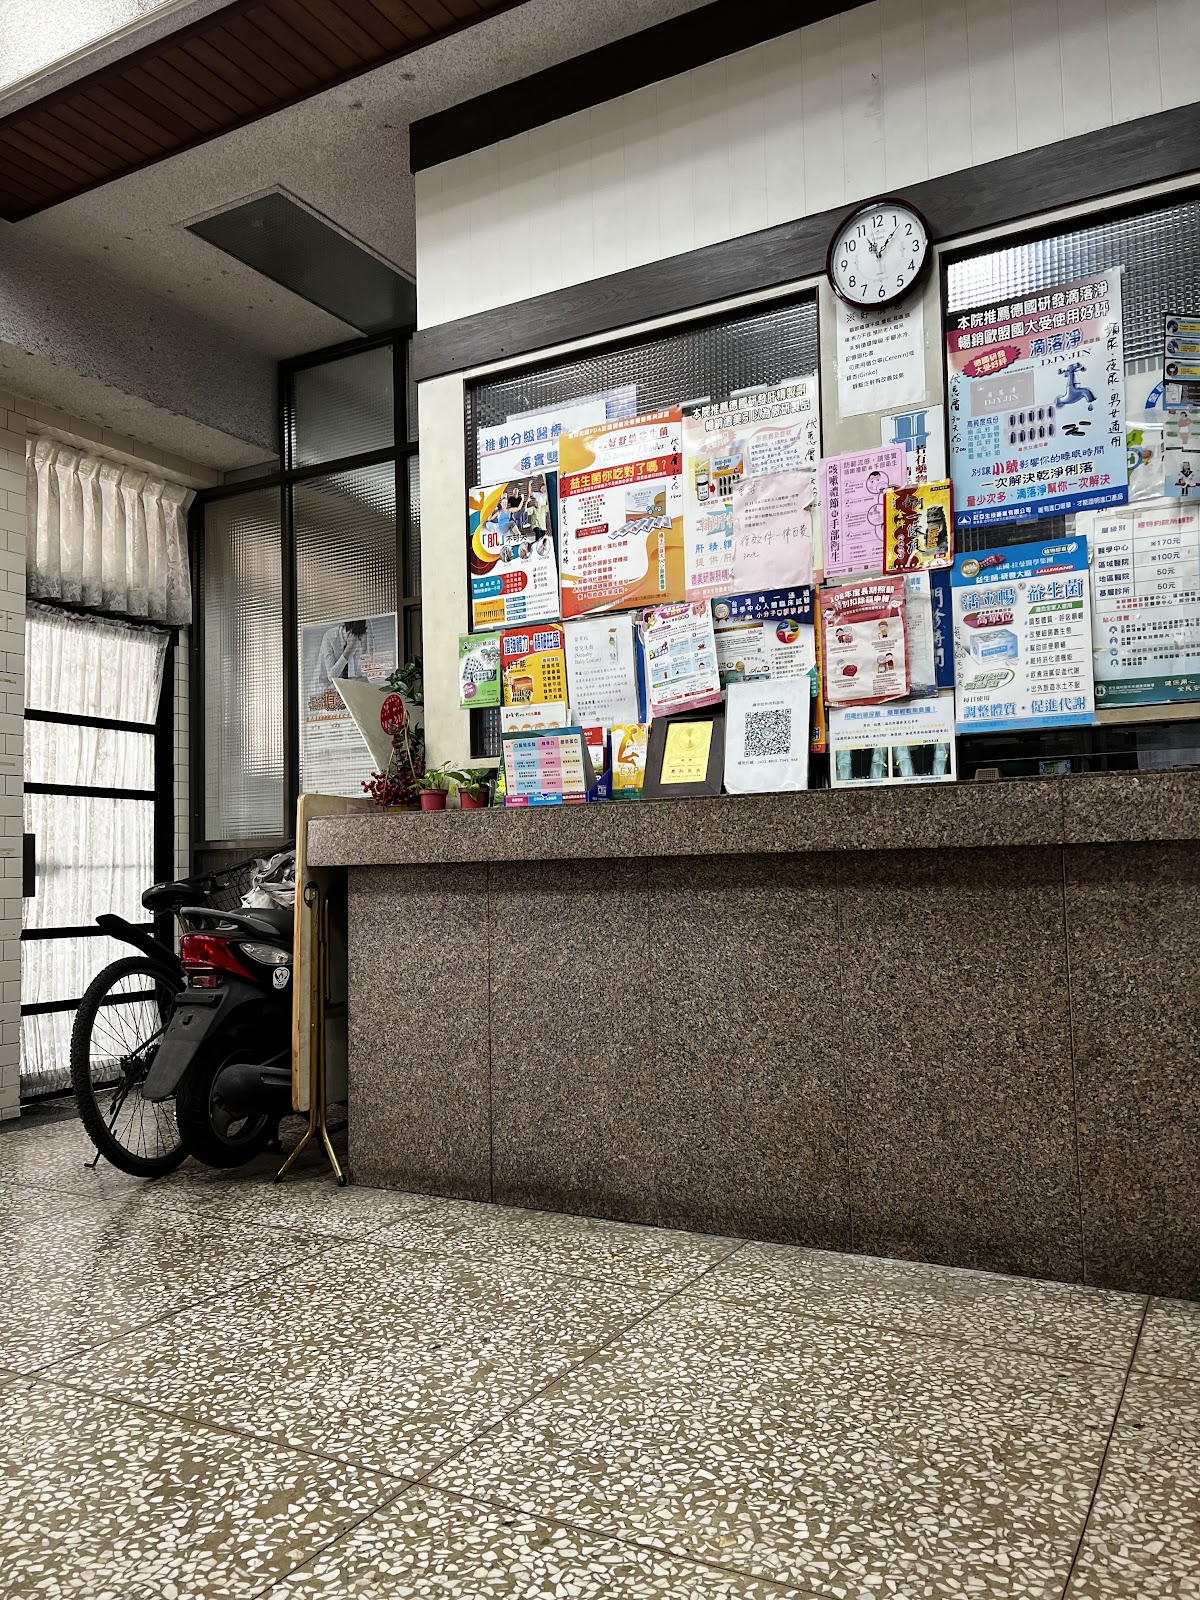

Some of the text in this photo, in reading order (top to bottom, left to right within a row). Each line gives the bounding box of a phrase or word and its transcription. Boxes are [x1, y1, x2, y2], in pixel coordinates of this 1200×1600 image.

[871, 214, 883, 228] 12
[892, 215, 897, 227] 1
[856, 225, 866, 237] 11
[905, 223, 912, 236] 2
[844, 240, 856, 253] 10
[912, 240, 920, 252] 3
[841, 260, 848, 272] 9
[908, 259, 915, 270] 4
[848, 276, 856, 287] 8
[896, 274, 904, 287] 5
[861, 284, 868, 296] 7
[878, 285, 885, 297] 6
[957, 280, 1108, 330] 本院推薦德國研發滴落淨
[958, 300, 1110, 350] 暢銷歐盟國大受使用好評
[1029, 328, 1082, 357] 滴落淨
[485, 423, 562, 452] 推動分級醫療
[521, 450, 558, 470] 落實雙
[981, 462, 1093, 489] 一次解決乾淨俐落
[1098, 544, 1129, 554] 醫學中心
[1036, 565, 1074, 574] LALLEMAND
[1157, 582, 1176, 590] 50元
[963, 579, 1083, 610] 活立暢 益生菌
